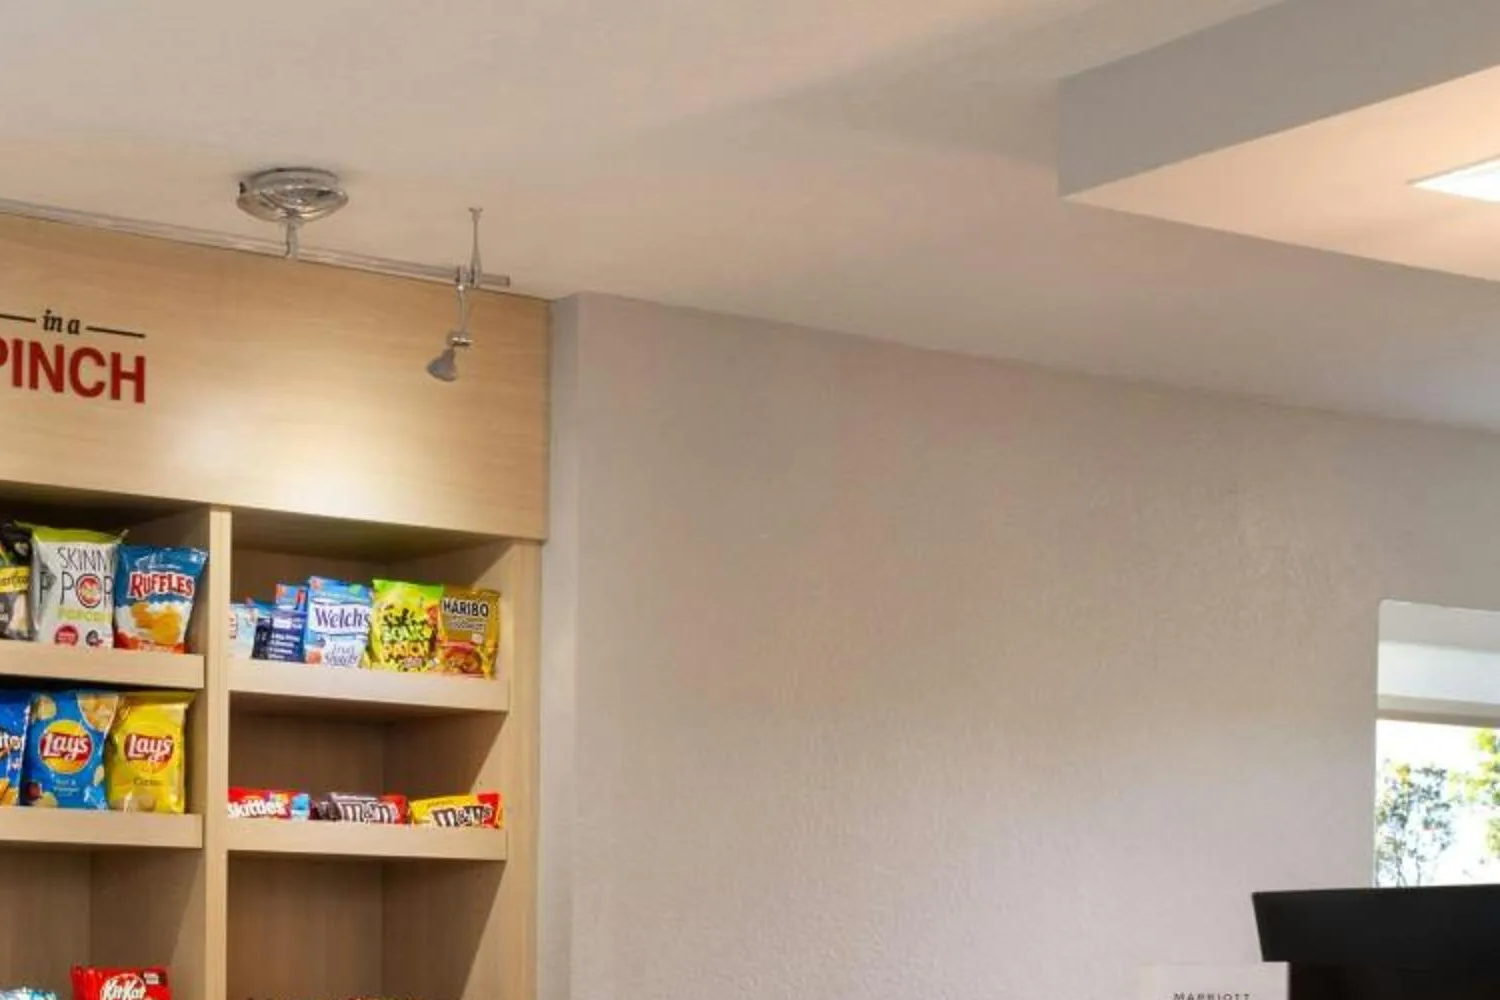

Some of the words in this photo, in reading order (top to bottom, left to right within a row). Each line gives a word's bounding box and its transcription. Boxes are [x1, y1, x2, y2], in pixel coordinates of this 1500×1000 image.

[42, 309, 63, 333] in
[67, 318, 81, 335] a
[128, 571, 195, 598] RUFFLES
[443, 599, 489, 617] HARIBO
